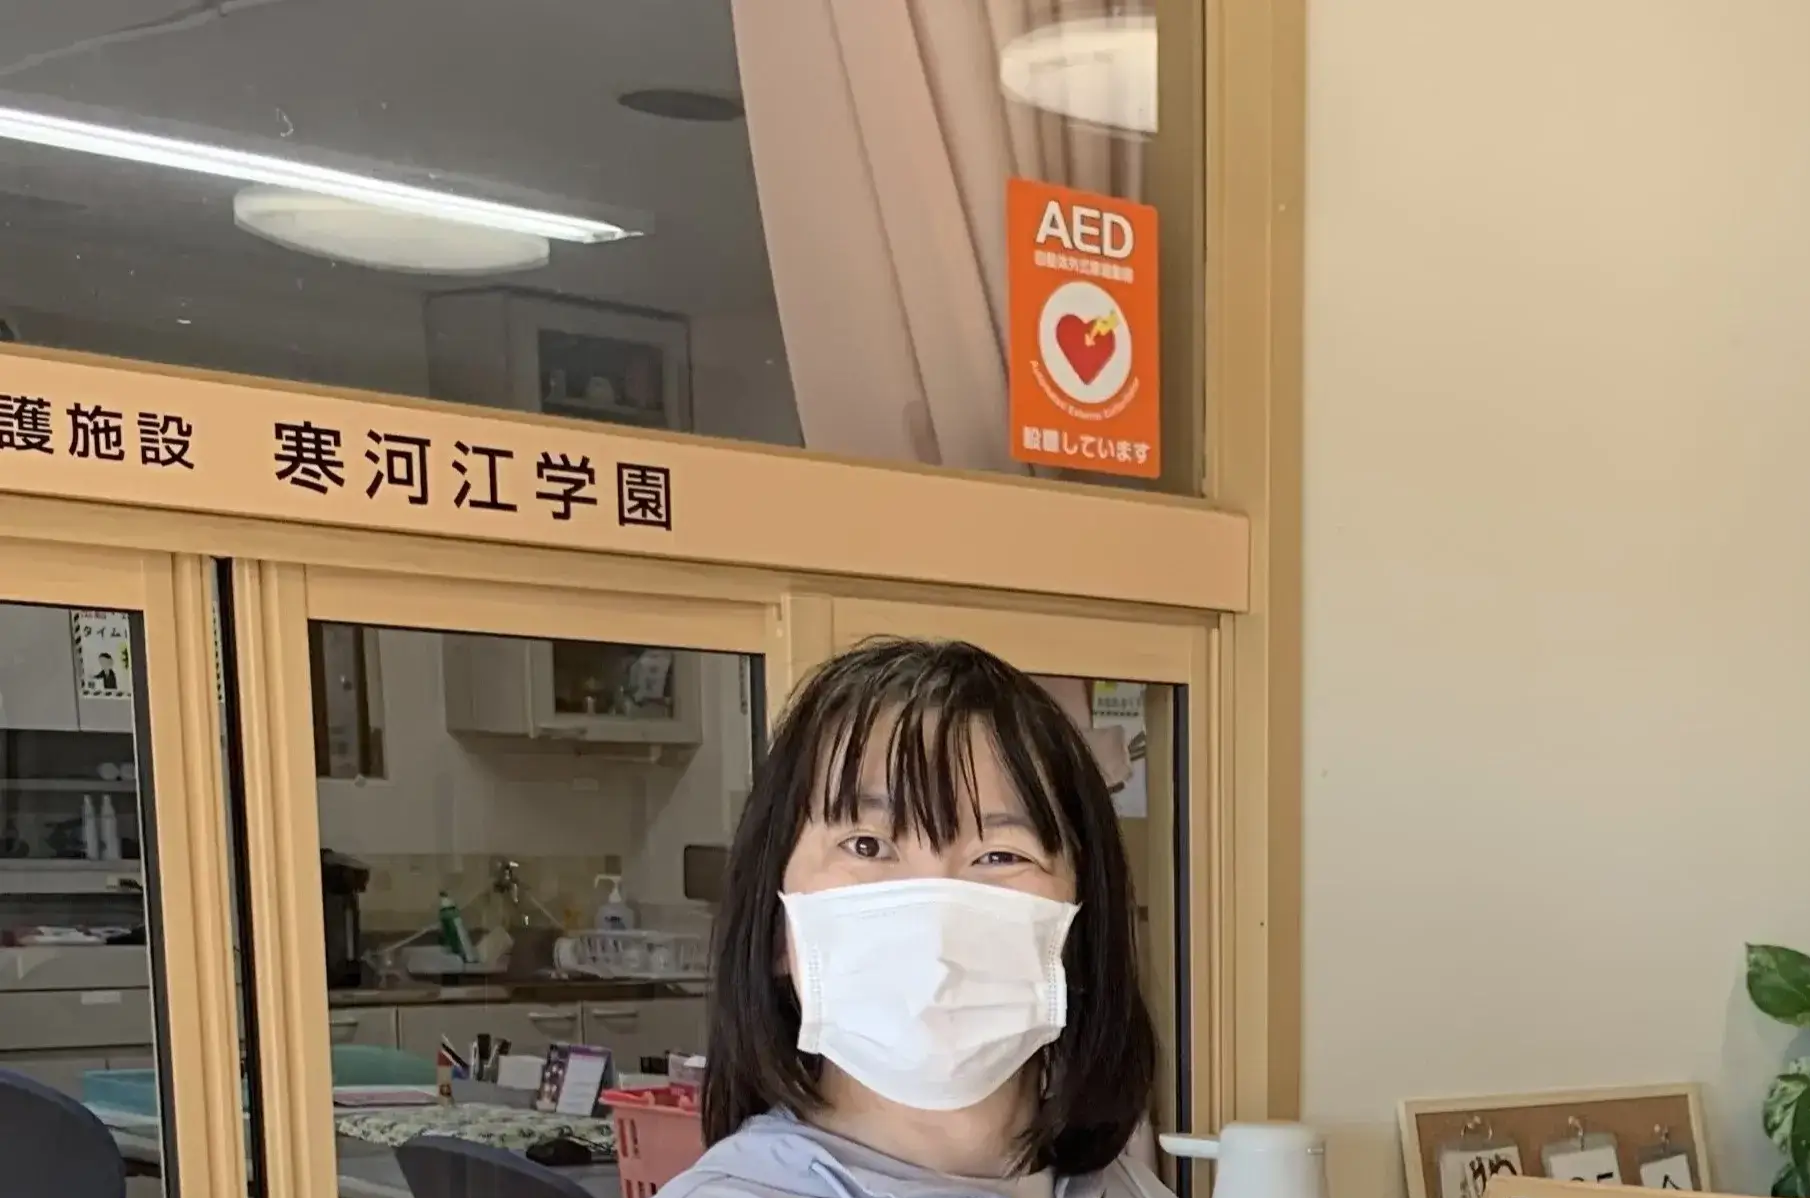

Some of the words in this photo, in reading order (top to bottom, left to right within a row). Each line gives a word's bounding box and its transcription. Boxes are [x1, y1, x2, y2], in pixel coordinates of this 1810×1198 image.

[1035, 200, 1134, 259] AED
[0, 394, 195, 470] 護施設
[273, 420, 673, 532] 寒河江学園
